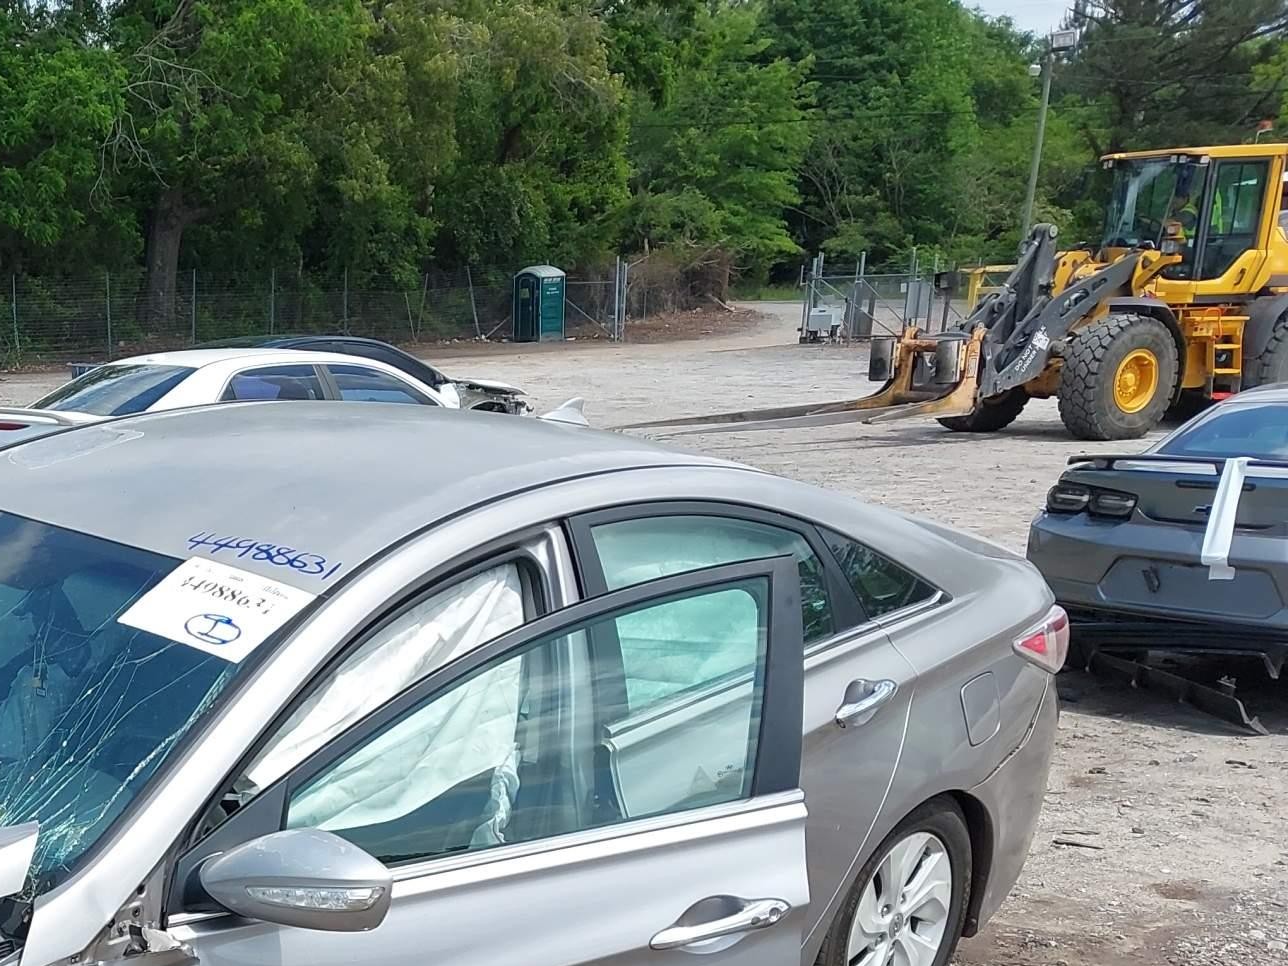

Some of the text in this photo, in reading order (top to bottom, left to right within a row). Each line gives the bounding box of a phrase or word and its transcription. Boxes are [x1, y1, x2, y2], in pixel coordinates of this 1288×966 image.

[1015, 344, 1032, 371] DO NOT
[187, 531, 342, 580] 44988631
